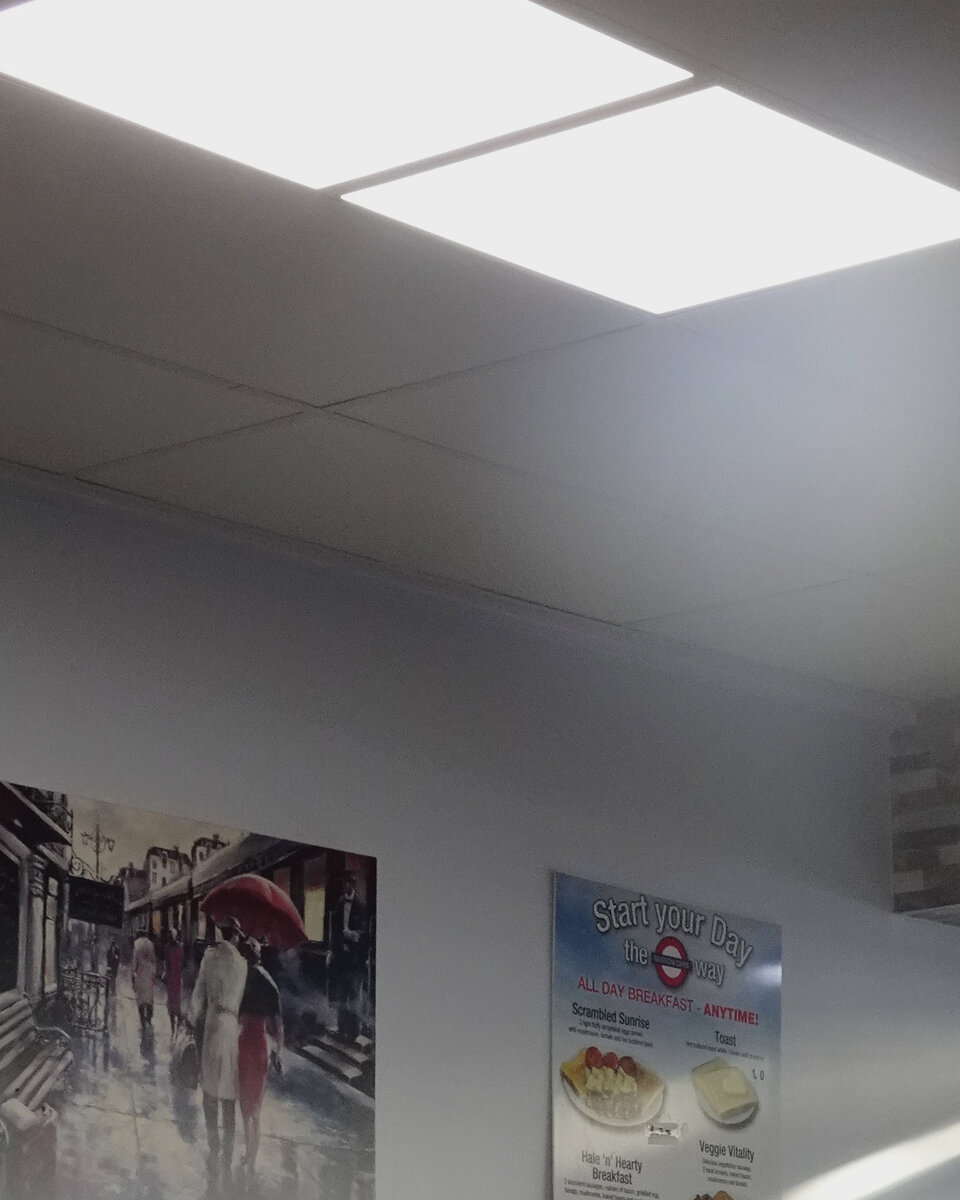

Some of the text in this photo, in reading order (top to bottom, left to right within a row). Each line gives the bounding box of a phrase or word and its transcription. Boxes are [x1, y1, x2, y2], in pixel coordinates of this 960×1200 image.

[593, 895, 648, 933] Start
[655, 902, 706, 938] your
[709, 913, 754, 968] Day
[624, 938, 648, 965] the
[695, 957, 725, 986] way
[578, 976, 599, 993] ALL
[601, 981, 626, 997] DAY
[627, 987, 693, 1013] BREAKFAST
[704, 1003, 759, 1026] ANYTIME!
[572, 1002, 617, 1025] Scrambled
[619, 1011, 650, 1031] Sunrise
[714, 1030, 737, 1048] Toast
[581, 1150, 643, 1174] Hale 'n' Hearty
[699, 1139, 755, 1163] Veggie Vitality
[592, 1166, 633, 1186] Breakfast
